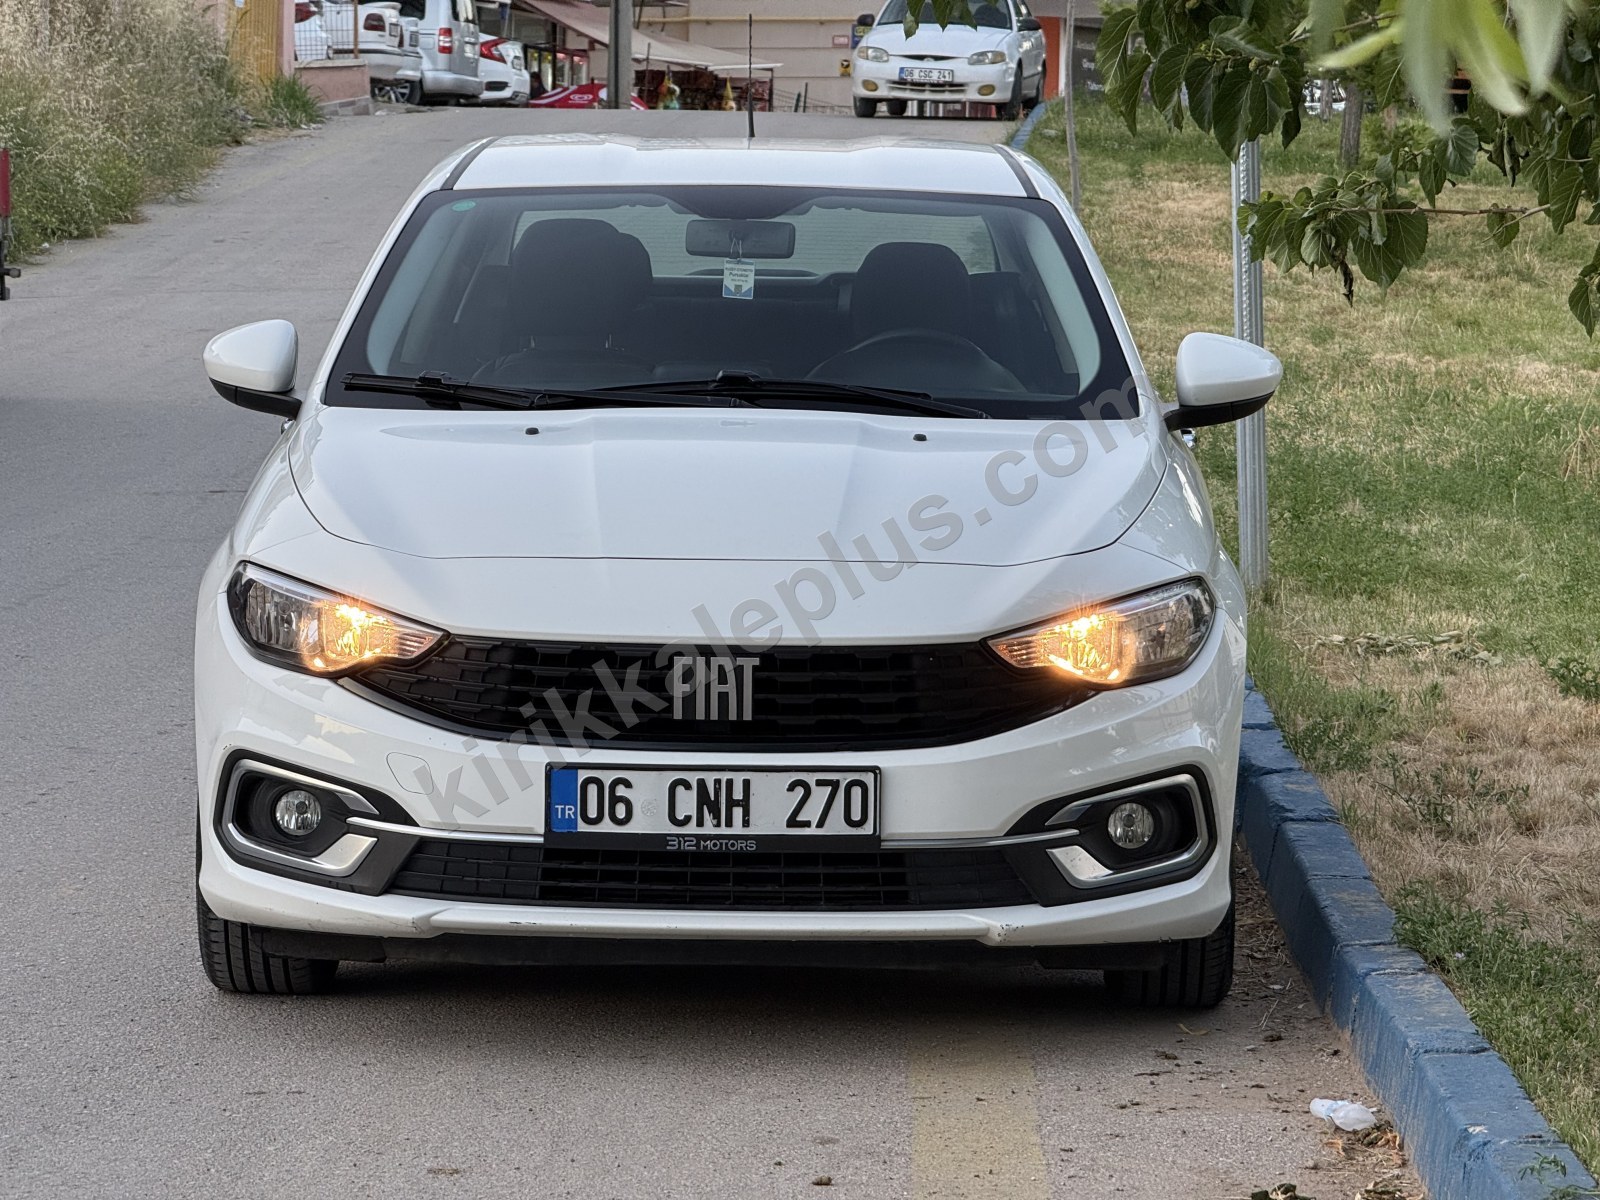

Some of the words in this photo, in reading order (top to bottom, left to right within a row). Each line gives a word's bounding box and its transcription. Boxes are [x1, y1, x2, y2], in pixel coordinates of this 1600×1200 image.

[904, 69, 914, 78] 06
[918, 69, 933, 79] CSC
[937, 70, 951, 80] 241
[673, 656, 760, 721] FIAT
[555, 805, 575, 819] TR
[580, 776, 633, 826] 06
[667, 777, 751, 828] CNH
[786, 778, 869, 829] 270
[666, 836, 697, 850] 312
[700, 839, 757, 851] MOTORS
